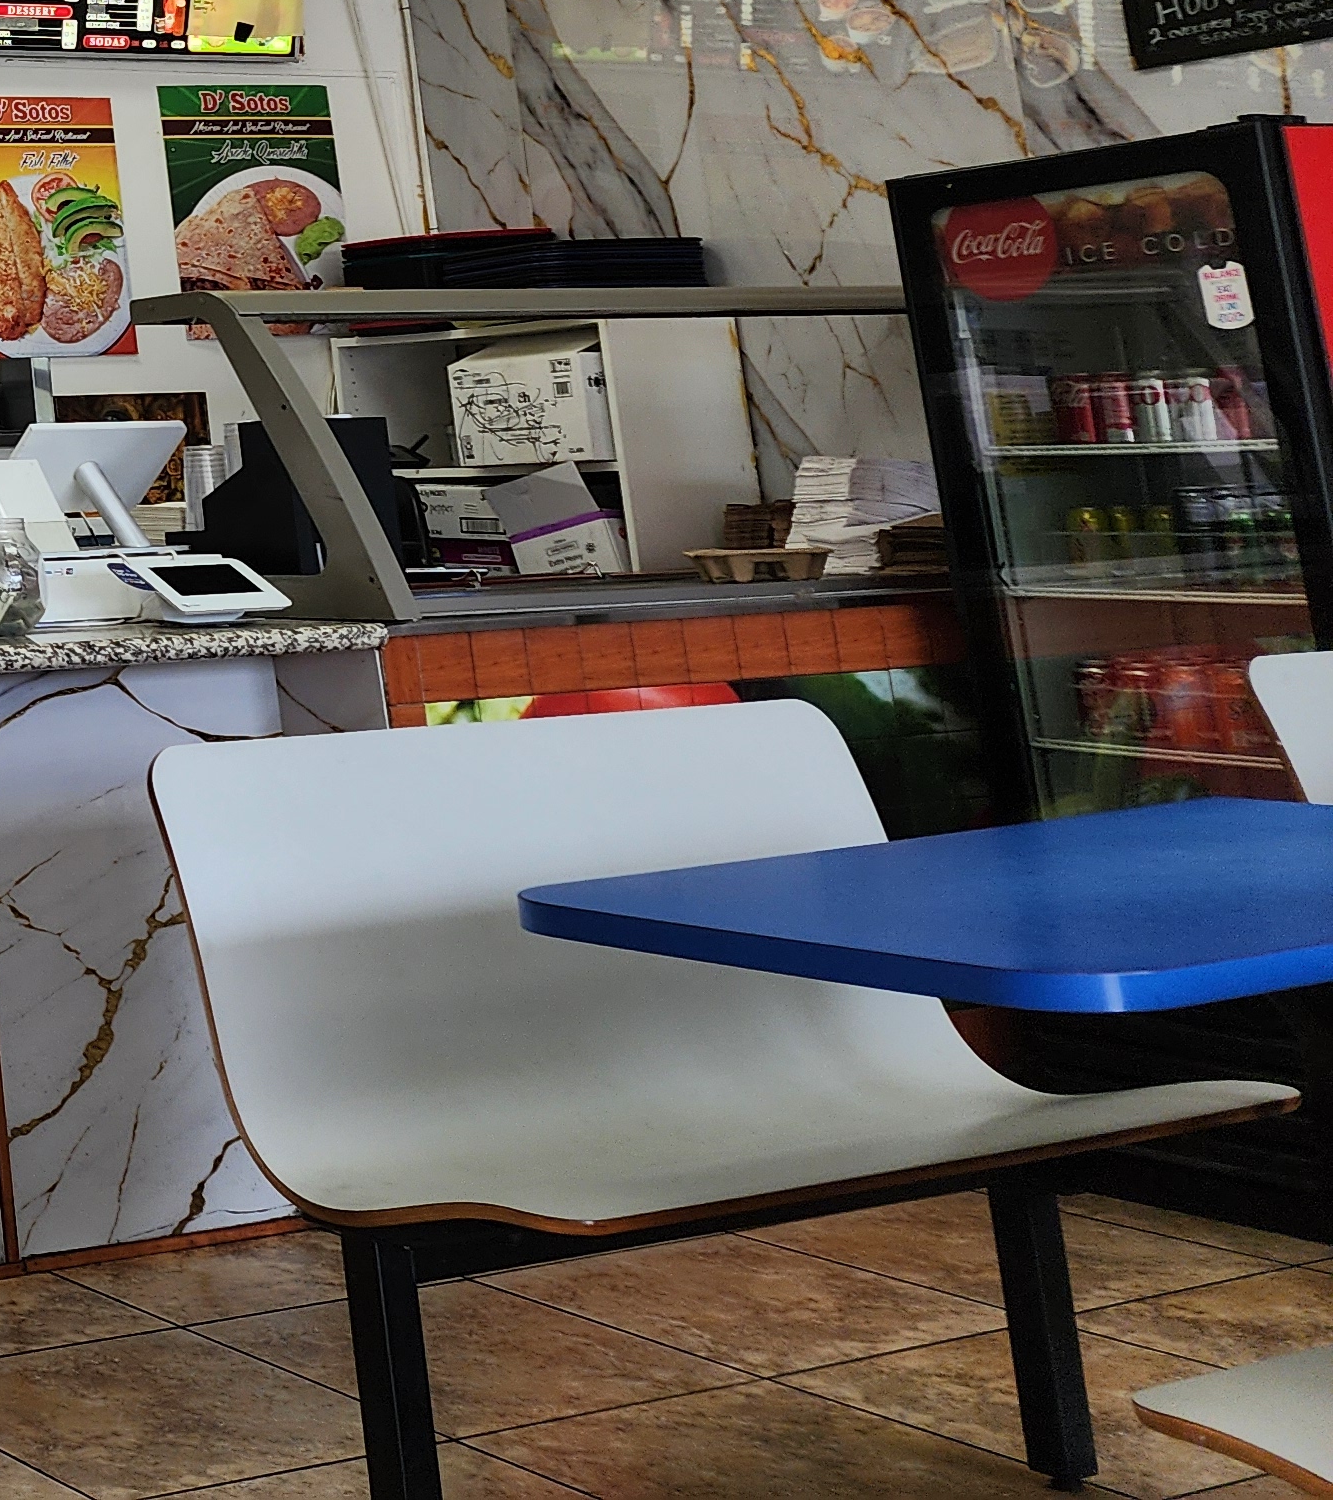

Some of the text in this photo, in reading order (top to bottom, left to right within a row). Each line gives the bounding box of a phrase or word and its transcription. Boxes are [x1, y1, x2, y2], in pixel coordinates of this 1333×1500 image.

[7, 6, 56, 16] DESSERT
[89, 37, 126, 47] SODAS
[12, 100, 72, 122] Sotos
[229, 91, 290, 113] Sotos
[20, 151, 46, 171] Fish
[1065, 242, 1115, 264] ICE
[1141, 227, 1234, 254] COLD
